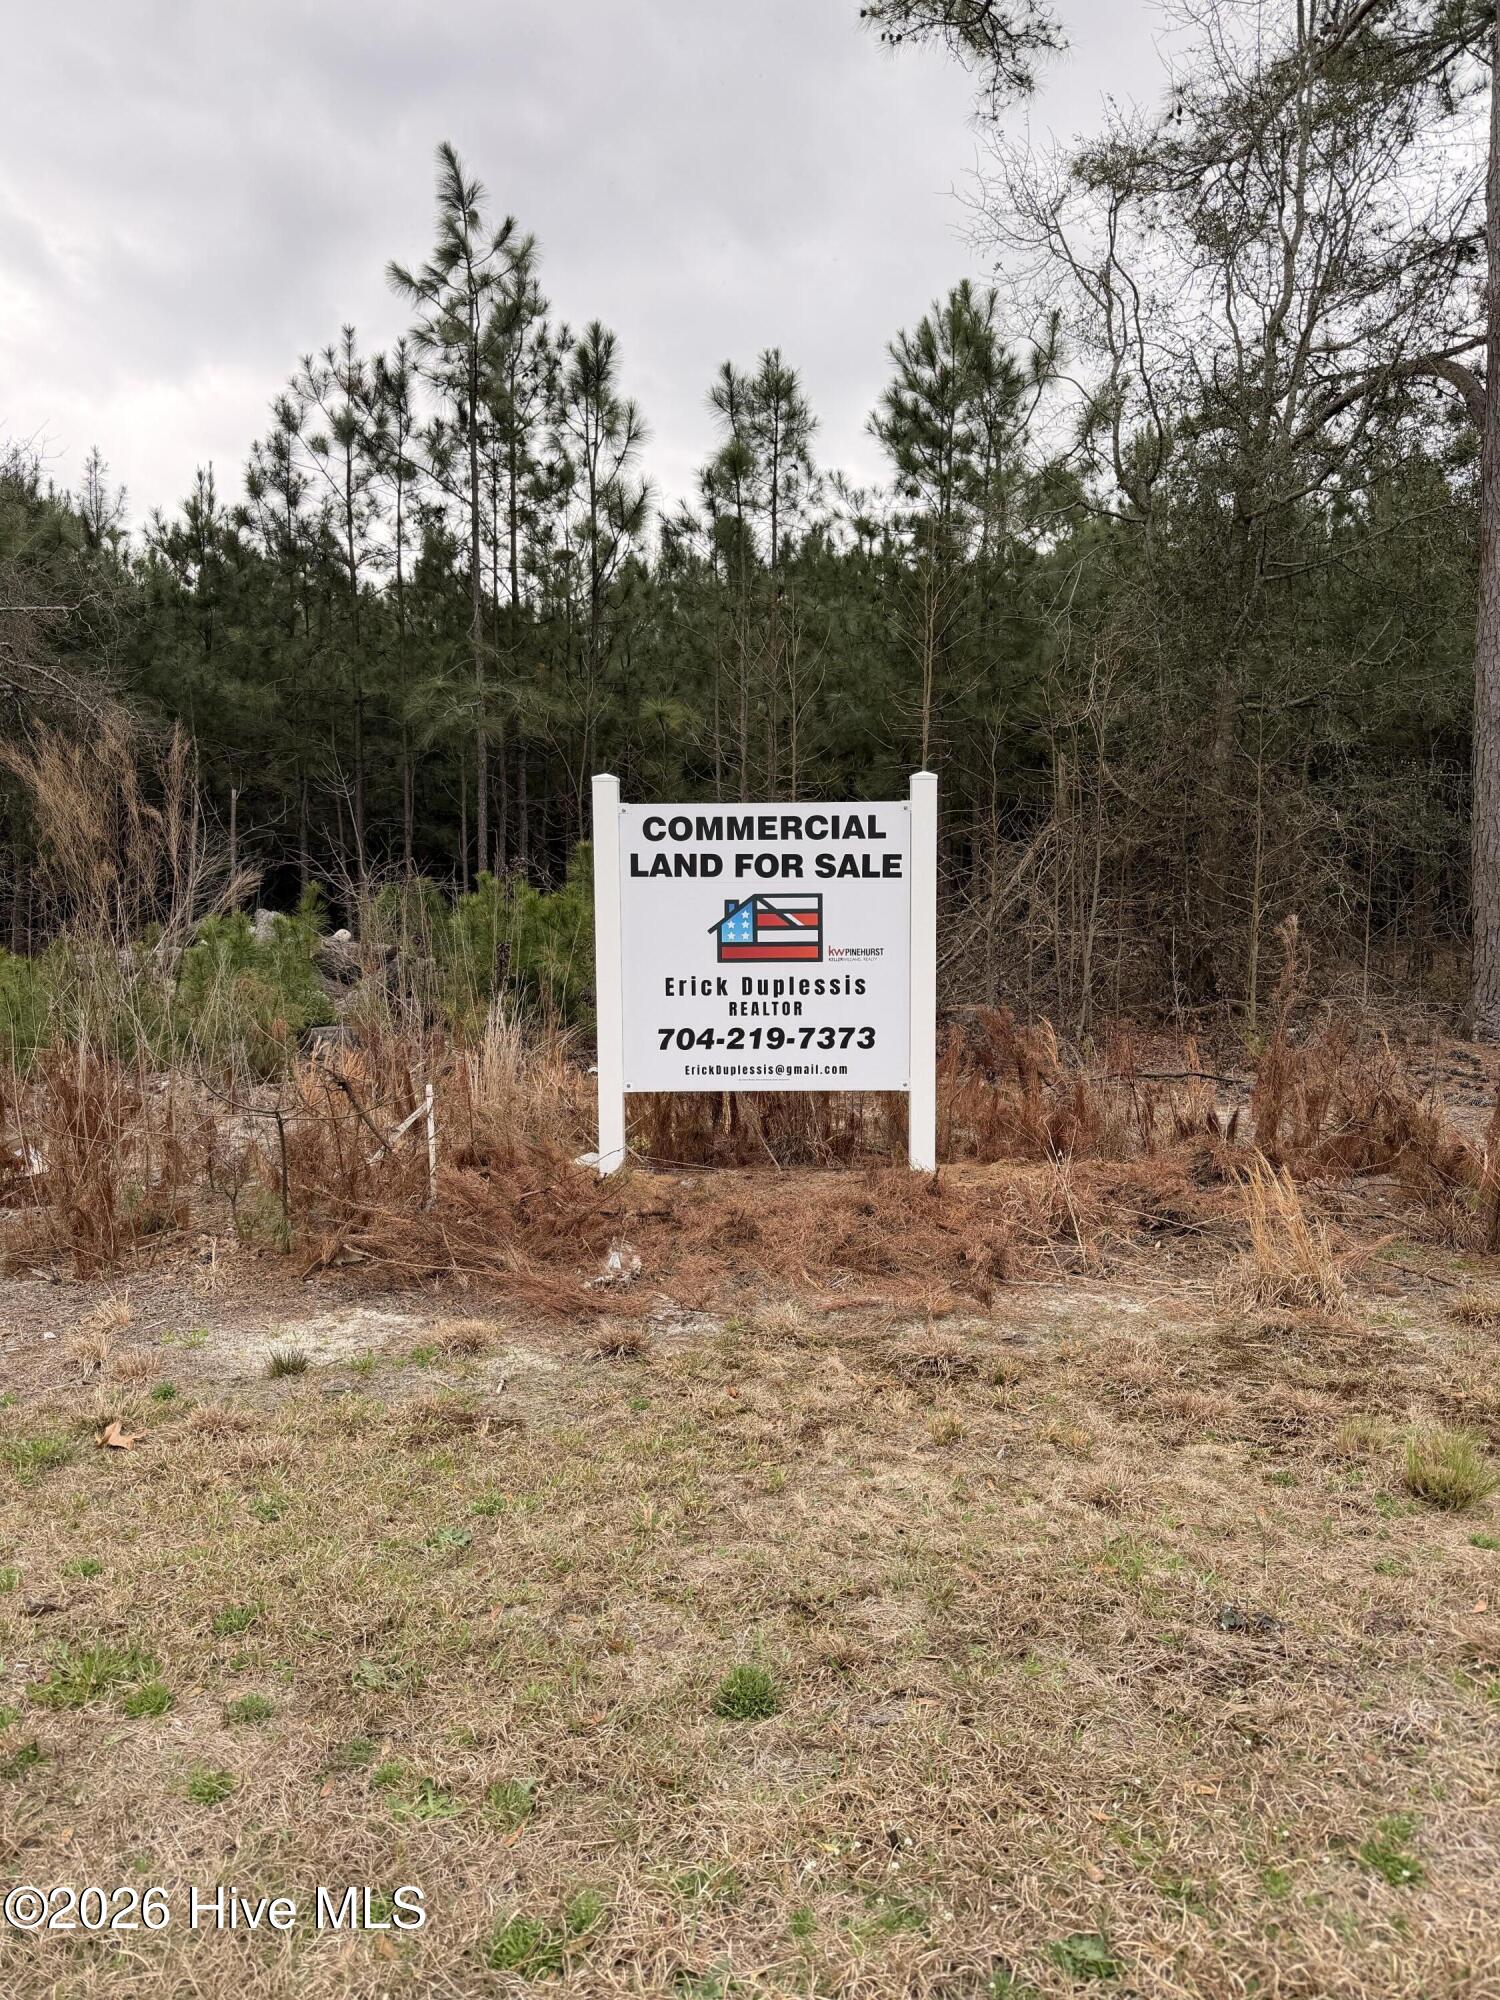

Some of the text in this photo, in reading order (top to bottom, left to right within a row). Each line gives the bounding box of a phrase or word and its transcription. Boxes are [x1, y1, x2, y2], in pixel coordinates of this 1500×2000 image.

[642, 814, 887, 842] COMMERCIAL
[630, 852, 903, 879] LAND FOR SALE
[665, 974, 867, 999] Erick Duplessis
[728, 1001, 803, 1017] REALTOR
[657, 1026, 876, 1051] 704-219-7373
[684, 1063, 848, 1077] ErickDuplessis@gmail.com
